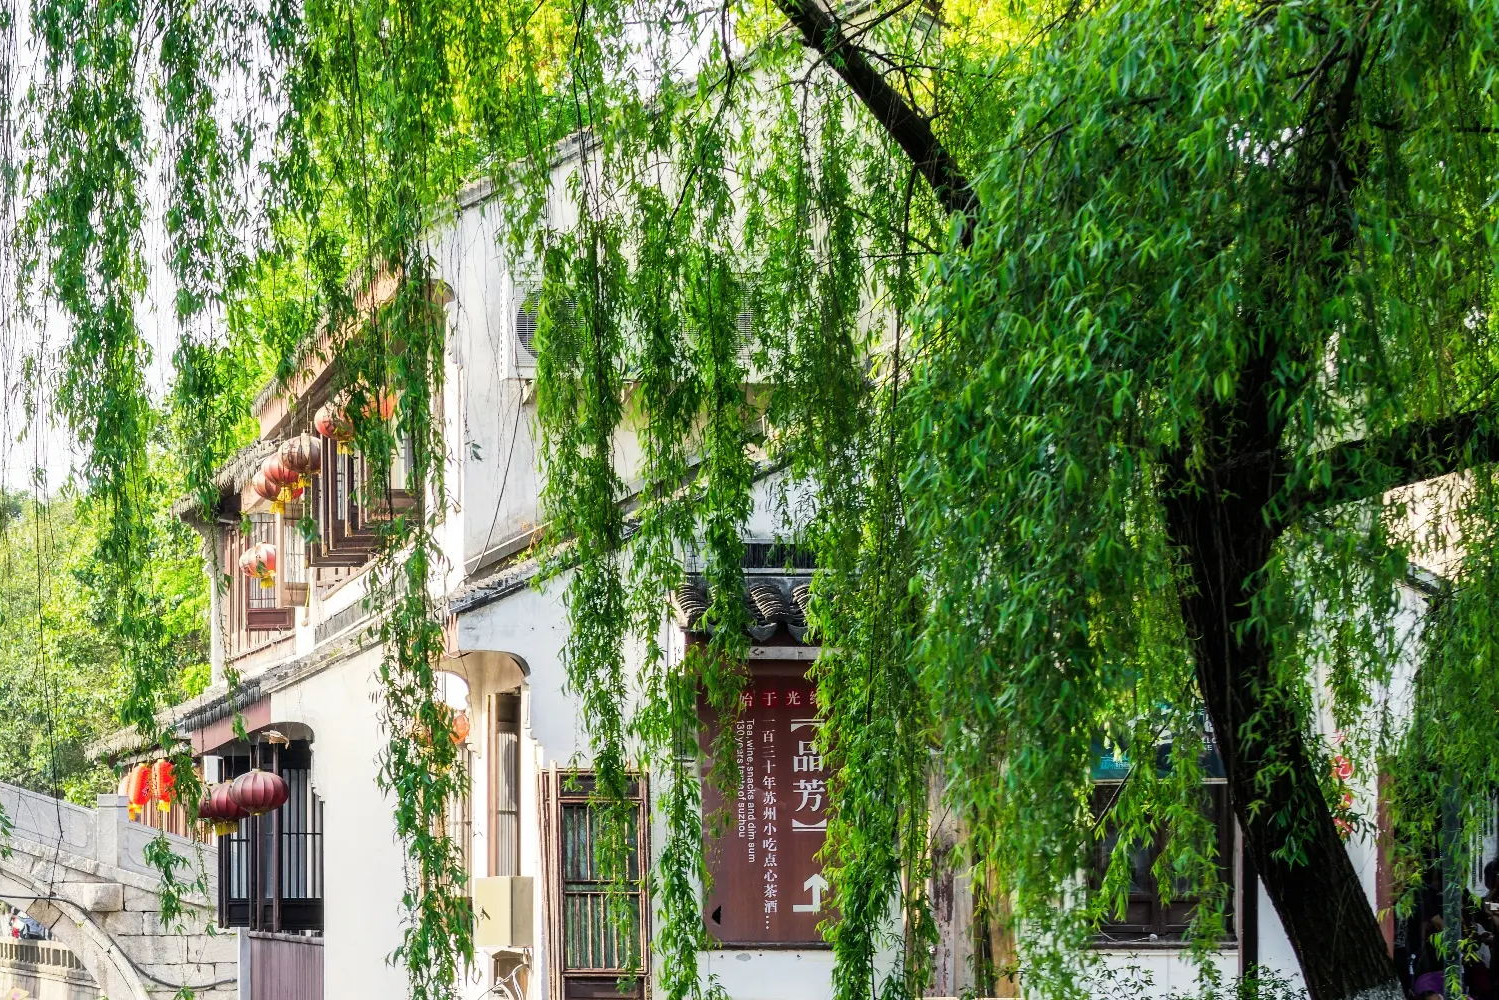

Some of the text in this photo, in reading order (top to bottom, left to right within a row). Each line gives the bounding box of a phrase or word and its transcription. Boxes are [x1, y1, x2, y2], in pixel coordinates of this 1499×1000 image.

[737, 802, 747, 838] suzhou
[747, 802, 756, 821] and
[747, 822, 757, 840] dim
[747, 842, 756, 863] sum
